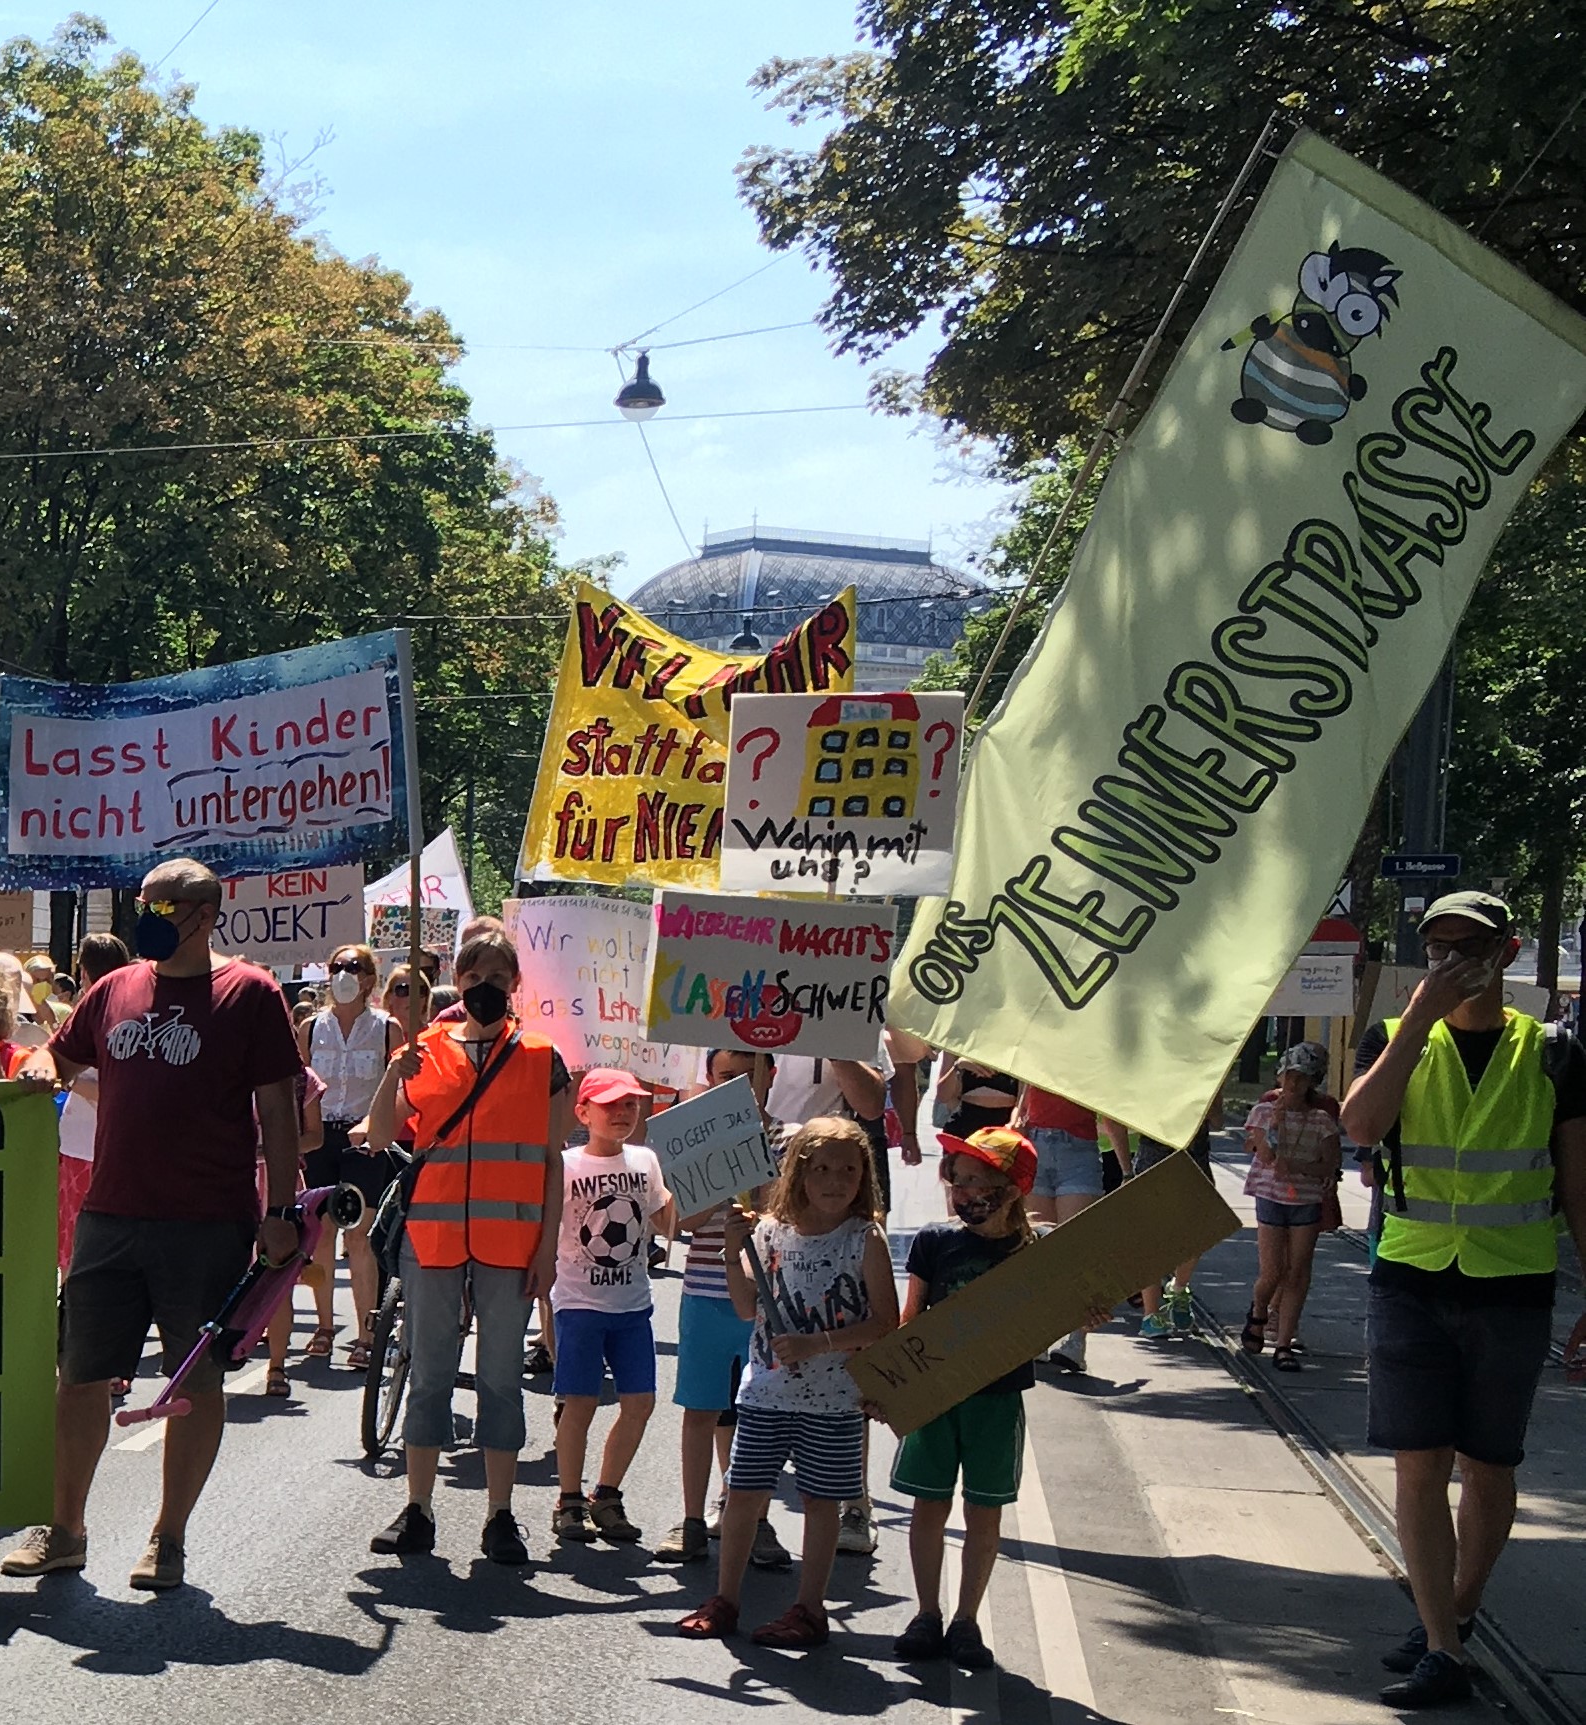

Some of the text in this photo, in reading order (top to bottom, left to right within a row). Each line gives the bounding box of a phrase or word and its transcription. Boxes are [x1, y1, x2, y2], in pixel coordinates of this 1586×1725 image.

[989, 346, 1536, 1010] ZENNERSTRASSE
[25, 698, 382, 776] Lasst Kinder
[20, 747, 391, 840] nicht untergehen!
[555, 790, 630, 863] für
[731, 817, 928, 865] Wohin mit
[267, 871, 327, 898] KEIN
[522, 920, 573, 951] Wir
[578, 961, 630, 988] nicht
[525, 989, 584, 1019] dass
[771, 969, 890, 1024] SCHWER
[723, 1108, 752, 1129] DAS
[571, 1173, 648, 1200] AWESOME
[590, 1266, 632, 1285] GAME
[793, 1261, 818, 1271] MAKE
[805, 1273, 814, 1283] IT
[867, 1335, 945, 1389] WIR
